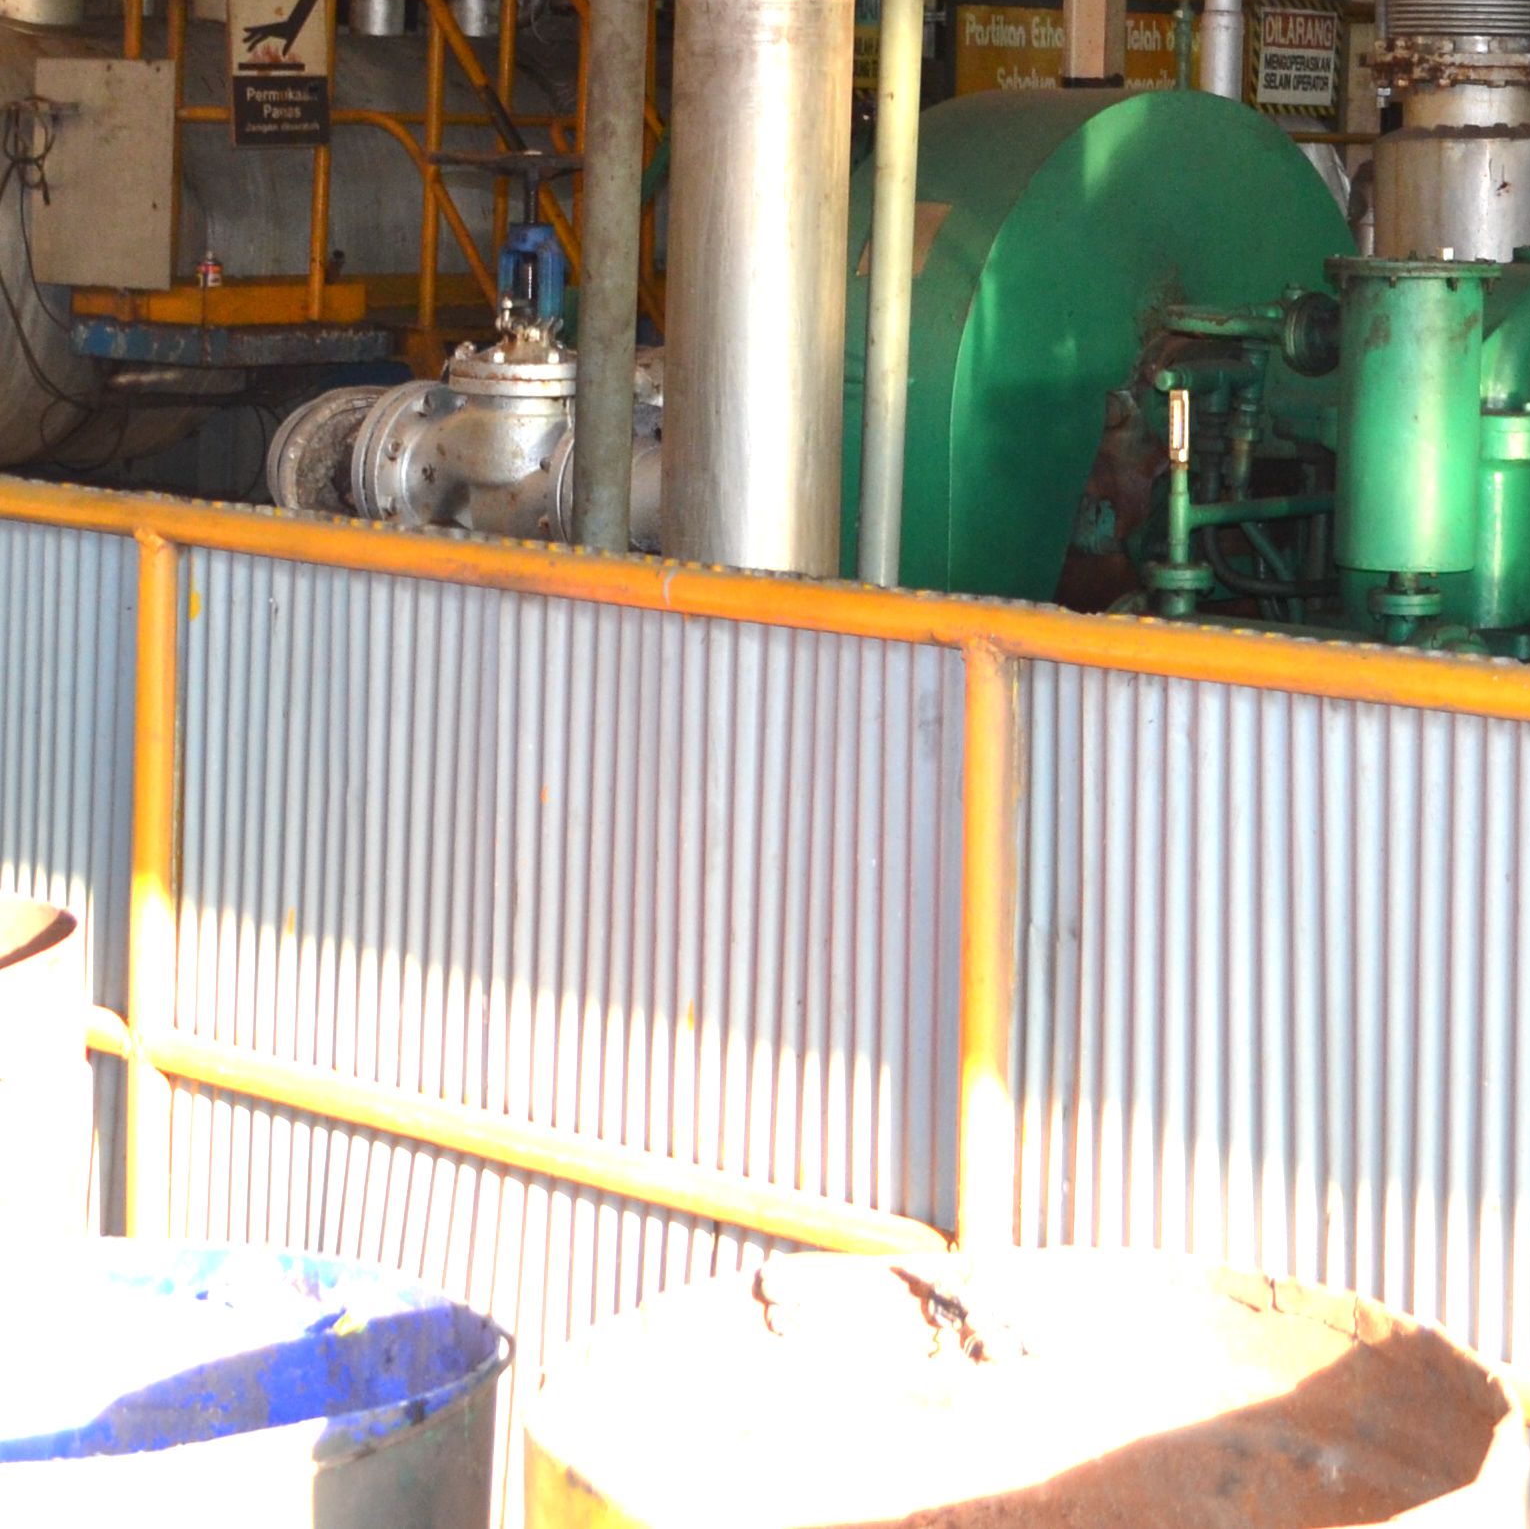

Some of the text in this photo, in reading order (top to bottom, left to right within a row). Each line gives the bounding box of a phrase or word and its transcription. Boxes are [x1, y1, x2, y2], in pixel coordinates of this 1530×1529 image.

[965, 13, 1026, 48] Pastikan
[1126, 20, 1161, 52] Telah
[1265, 14, 1333, 47] DILARANG
[1263, 53, 1332, 73] MENGOPERASIKAN
[1263, 72, 1329, 92] SELAIN OPERATOR
